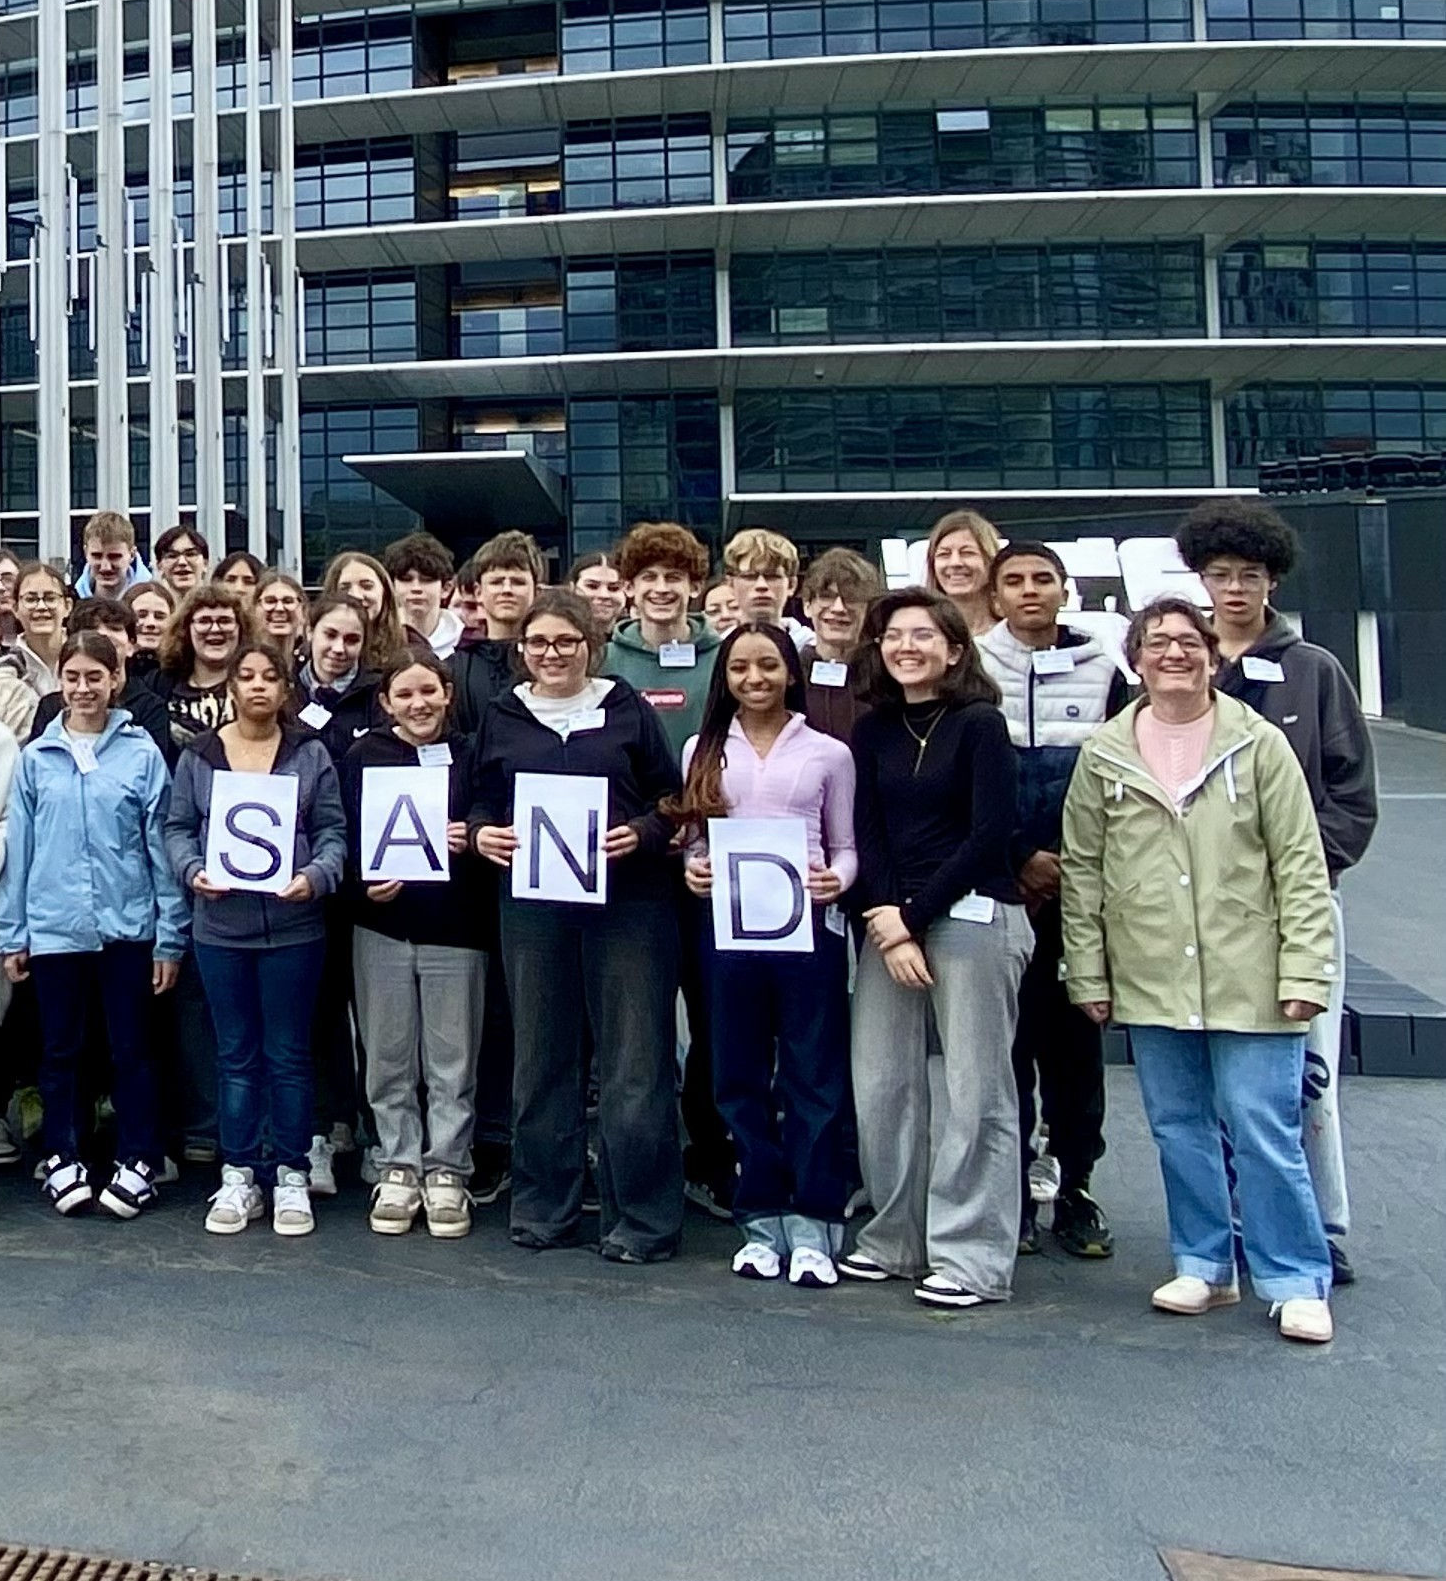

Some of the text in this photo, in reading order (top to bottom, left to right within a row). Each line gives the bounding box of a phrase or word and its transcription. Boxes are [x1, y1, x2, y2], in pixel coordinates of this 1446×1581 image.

[220, 802, 282, 881] S
[370, 794, 444, 872] A
[530, 806, 598, 893] N
[729, 853, 804, 940] D
